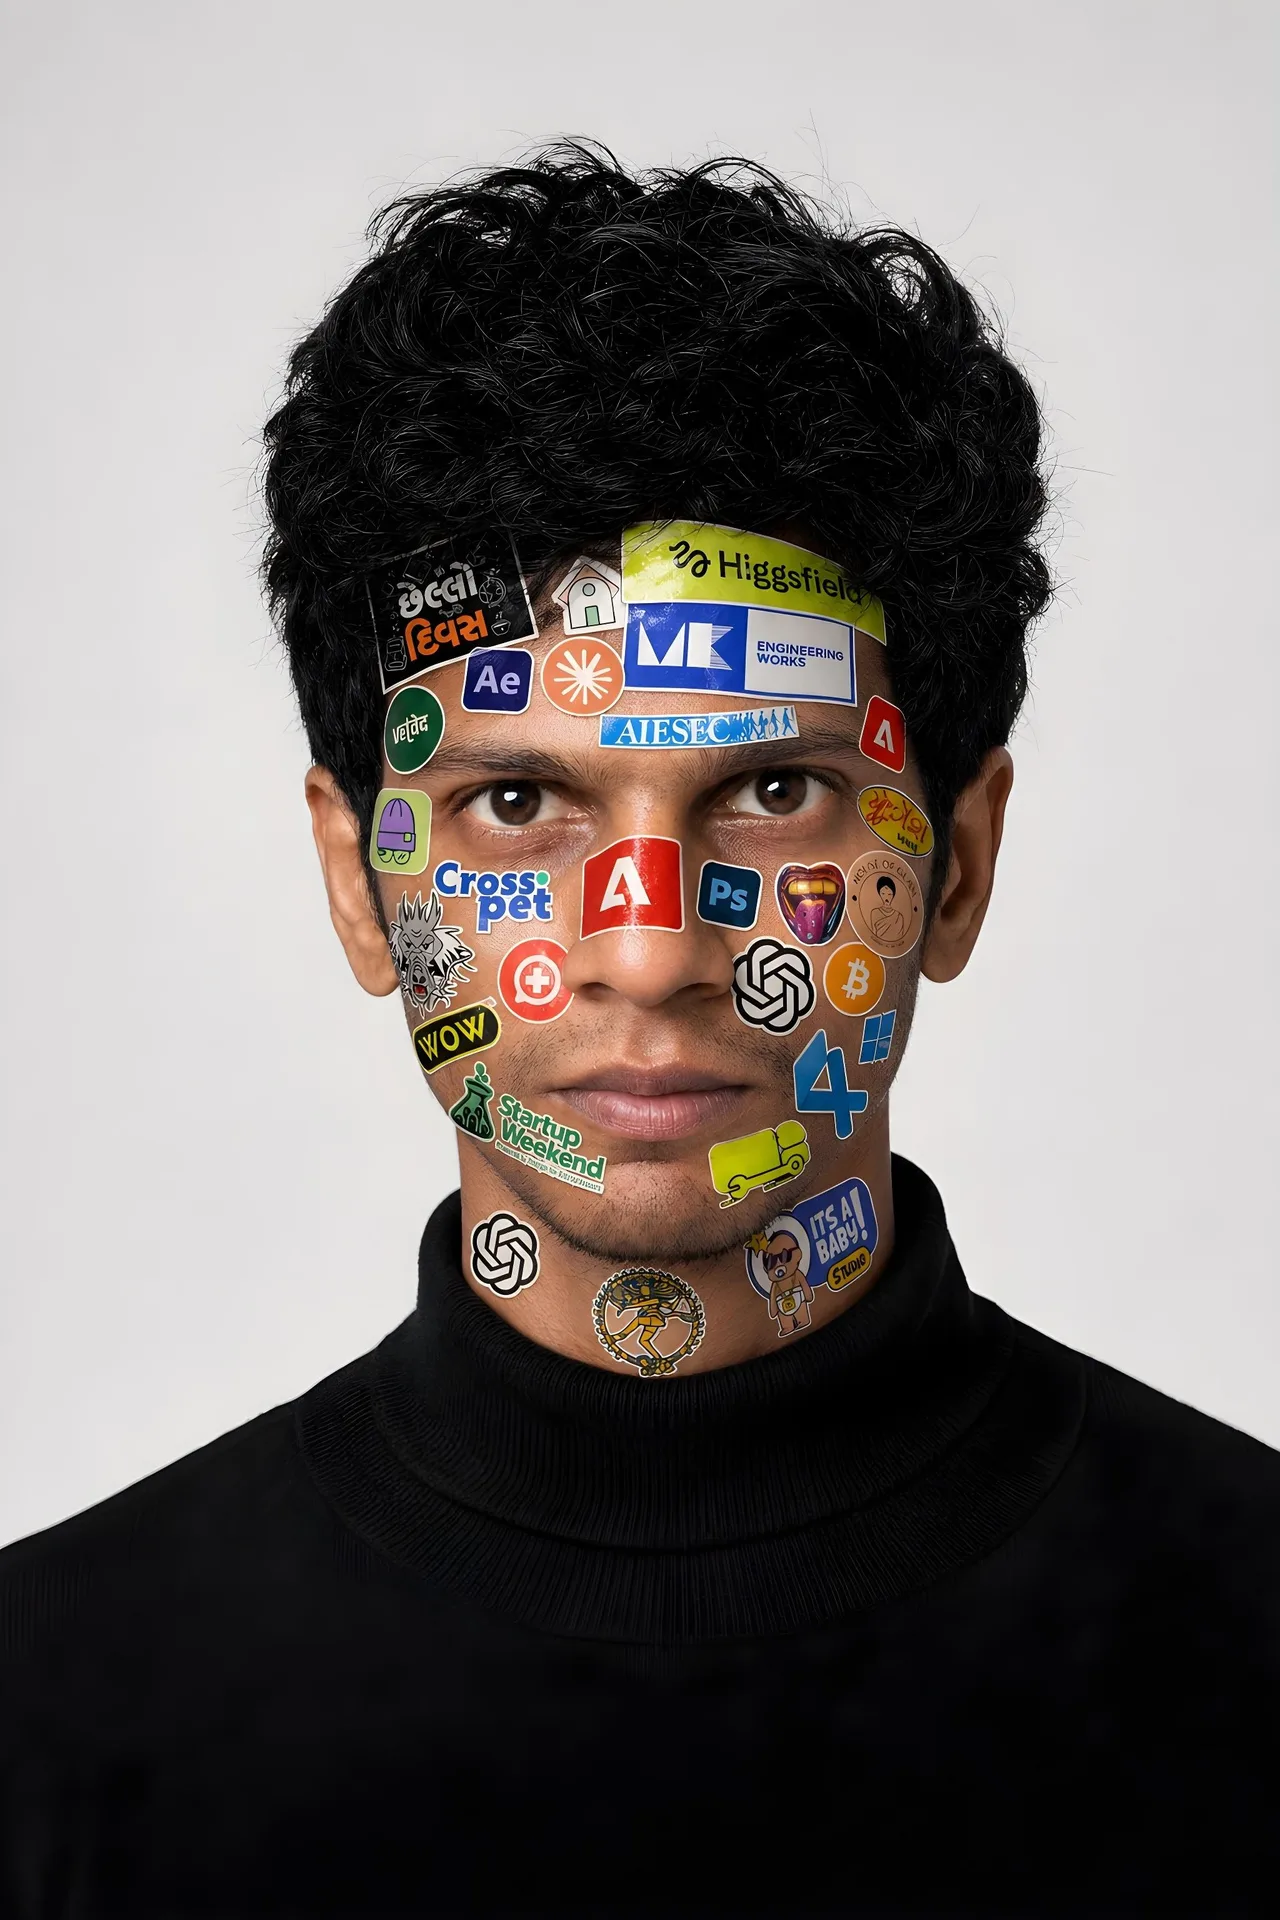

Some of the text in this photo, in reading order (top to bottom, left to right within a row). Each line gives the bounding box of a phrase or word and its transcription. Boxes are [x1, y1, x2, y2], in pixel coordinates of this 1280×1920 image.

[718, 550, 863, 604] Higgsfield
[405, 609, 489, 662] દિવસ
[757, 640, 844, 662] ENGINEERING
[473, 665, 521, 695] Ae
[757, 652, 806, 668] WORKS
[615, 715, 731, 746] AIESEC
[434, 862, 536, 896] Cross
[708, 877, 748, 912] Ps
[477, 887, 551, 932] pet
[418, 1012, 485, 1062] WOW
[499, 1095, 580, 1150] Startup
[502, 1117, 606, 1180] Weekend
[810, 1196, 853, 1240] ITS A
